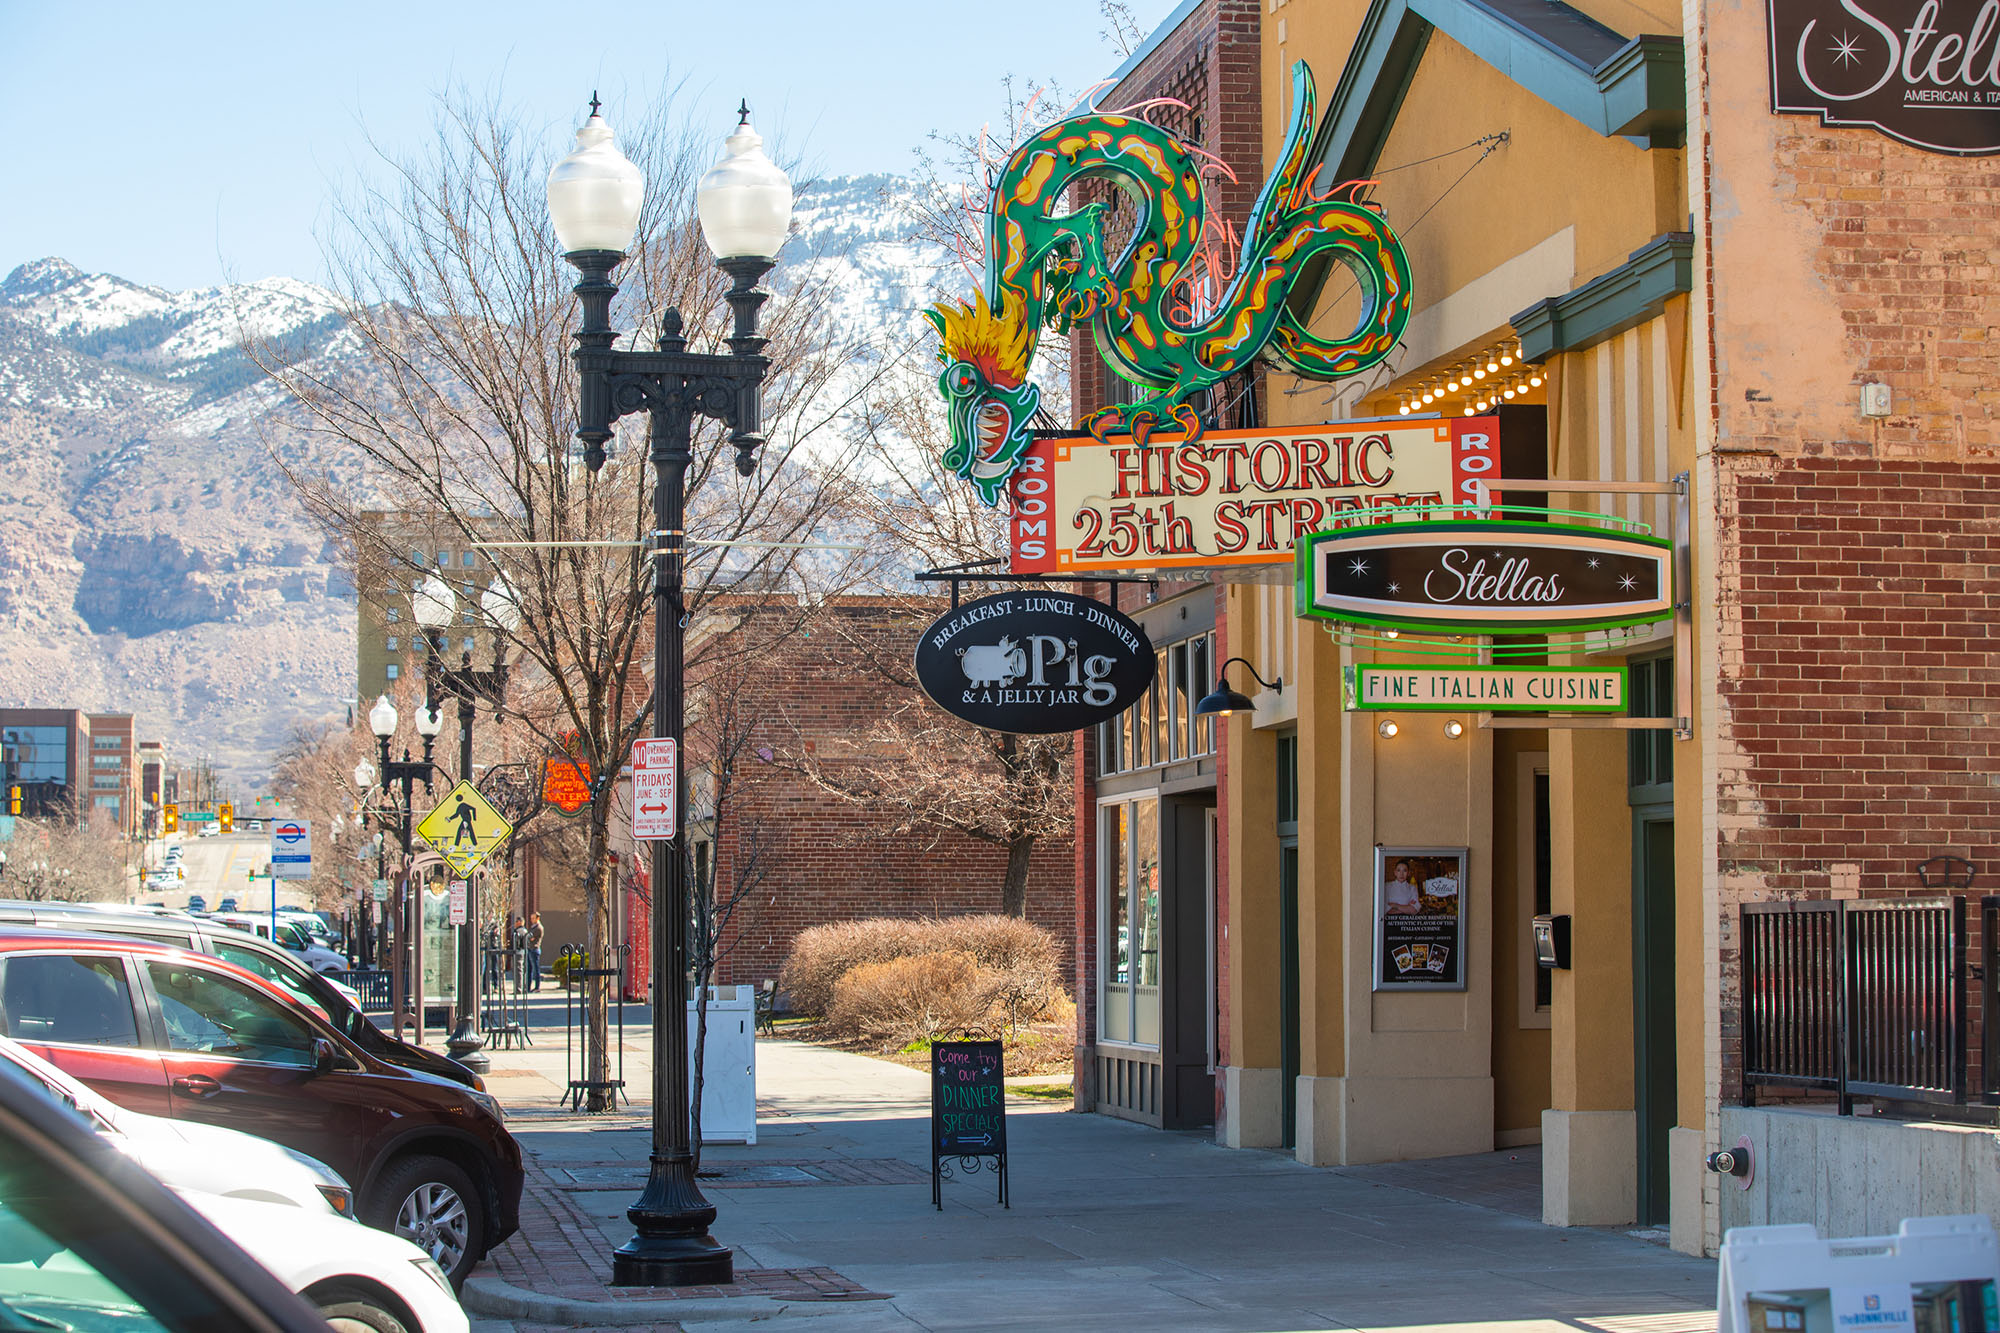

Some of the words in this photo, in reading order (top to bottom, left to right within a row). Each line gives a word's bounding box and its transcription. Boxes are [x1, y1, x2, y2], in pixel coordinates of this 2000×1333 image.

[1904, 89, 1968, 102] AMERICAN
[1973, 91, 1982, 103] &
[1110, 433, 1394, 498] HISTORIC
[1017, 456, 1049, 560] ROOMS
[1073, 501, 1196, 558] 25th
[1424, 548, 1565, 602] Stellas
[932, 599, 1013, 650] BREAKFAST
[1025, 598, 1075, 616] LUNCH
[1086, 608, 1140, 655] DINNER
[1026, 633, 1118, 706] Pig
[962, 690, 976, 703] &
[981, 690, 993, 703] A
[996, 689, 1046, 706] JELLY
[1048, 689, 1080, 706] JAR
[1370, 676, 1418, 697] FINE
[1431, 676, 1514, 698] ITALIAN
[1527, 678, 1614, 700] CUISINE
[634, 746, 646, 765] NO
[650, 755, 670, 765] PARKING
[636, 773, 672, 787] FRIDAYS
[636, 789, 652, 799] JUNE
[660, 788, 672, 798] SEP
[939, 1047, 970, 1065] Come
[977, 1050, 997, 1070] try
[958, 1069, 978, 1082] our
[943, 1085, 999, 1109] DINNER
[942, 1113, 1000, 1133] SPECIALS
